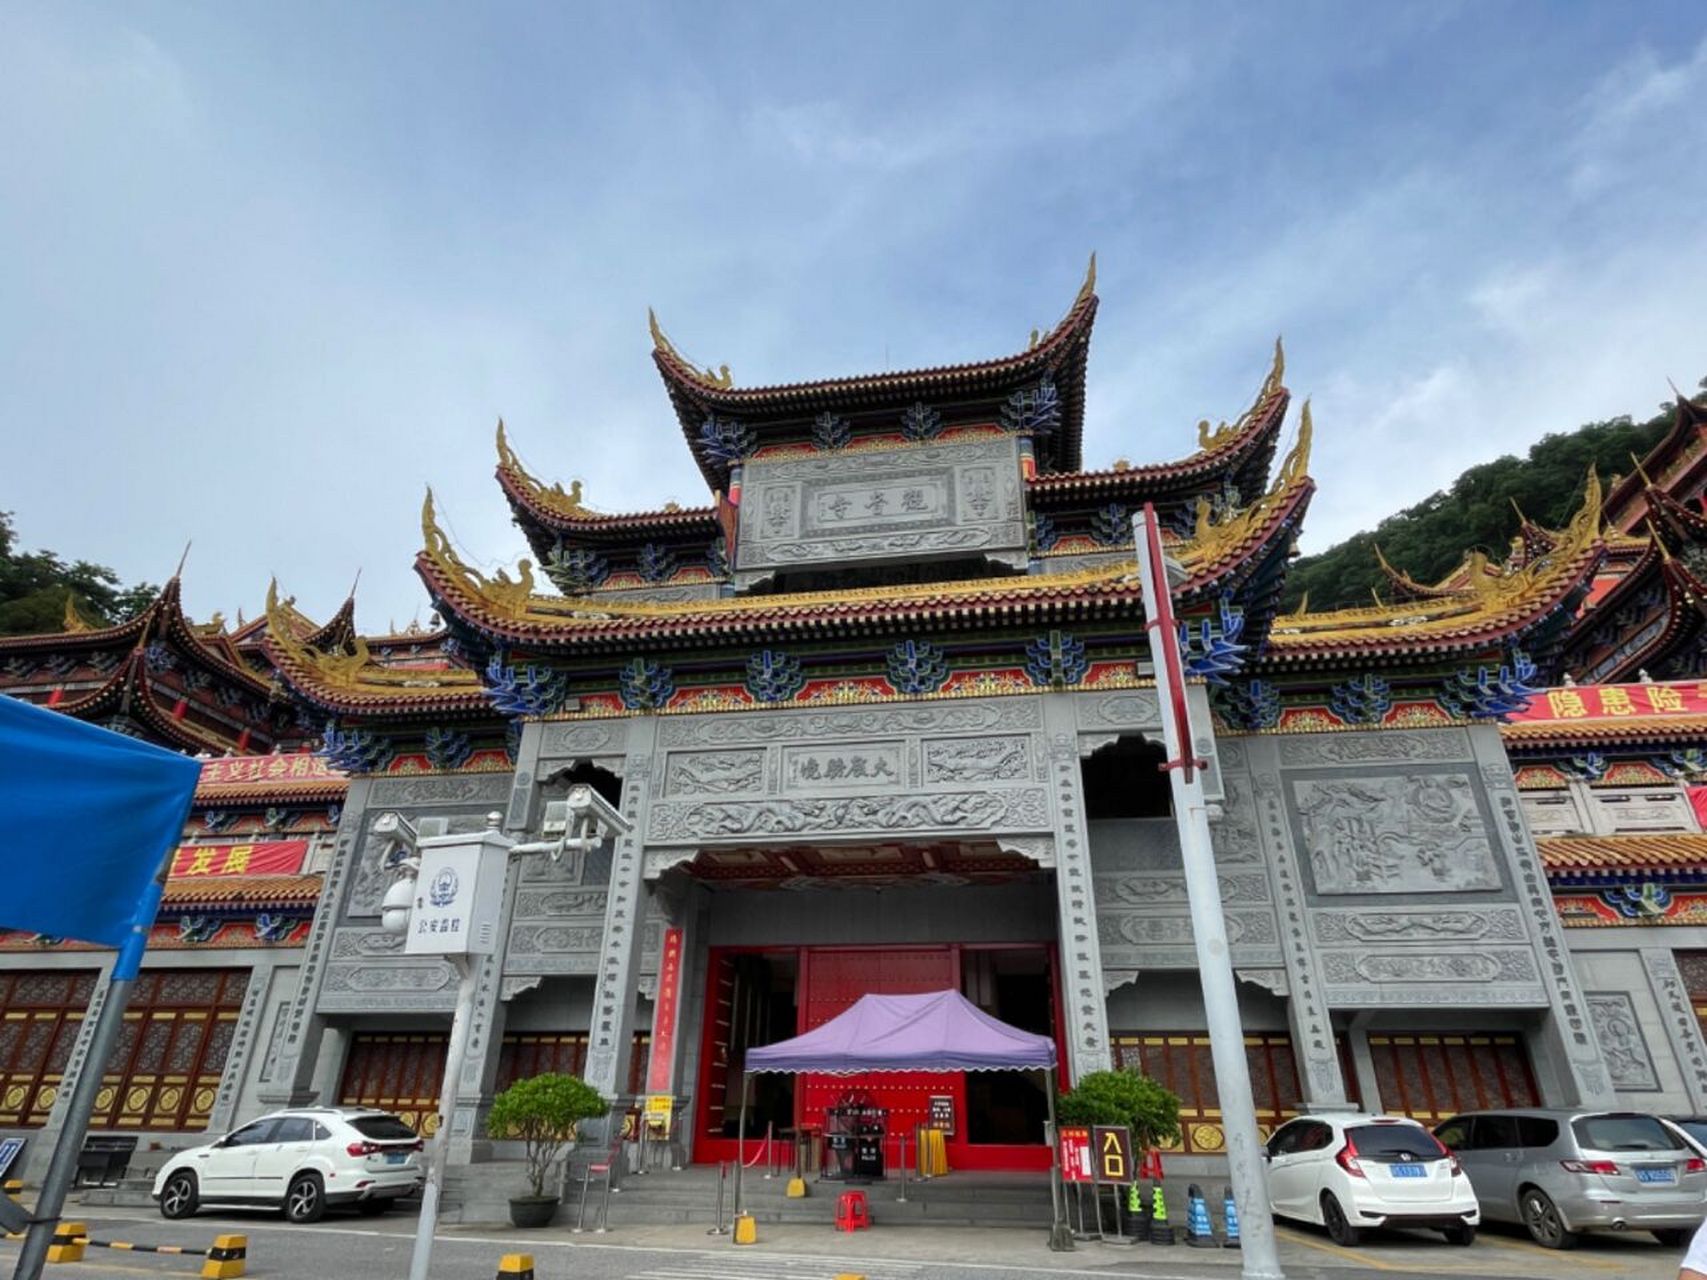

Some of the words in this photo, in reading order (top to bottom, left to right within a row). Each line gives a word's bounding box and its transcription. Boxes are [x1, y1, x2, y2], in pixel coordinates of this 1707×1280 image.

[1548, 685, 1707, 719] 隐患险
[1103, 1132, 1125, 1177] 入口
